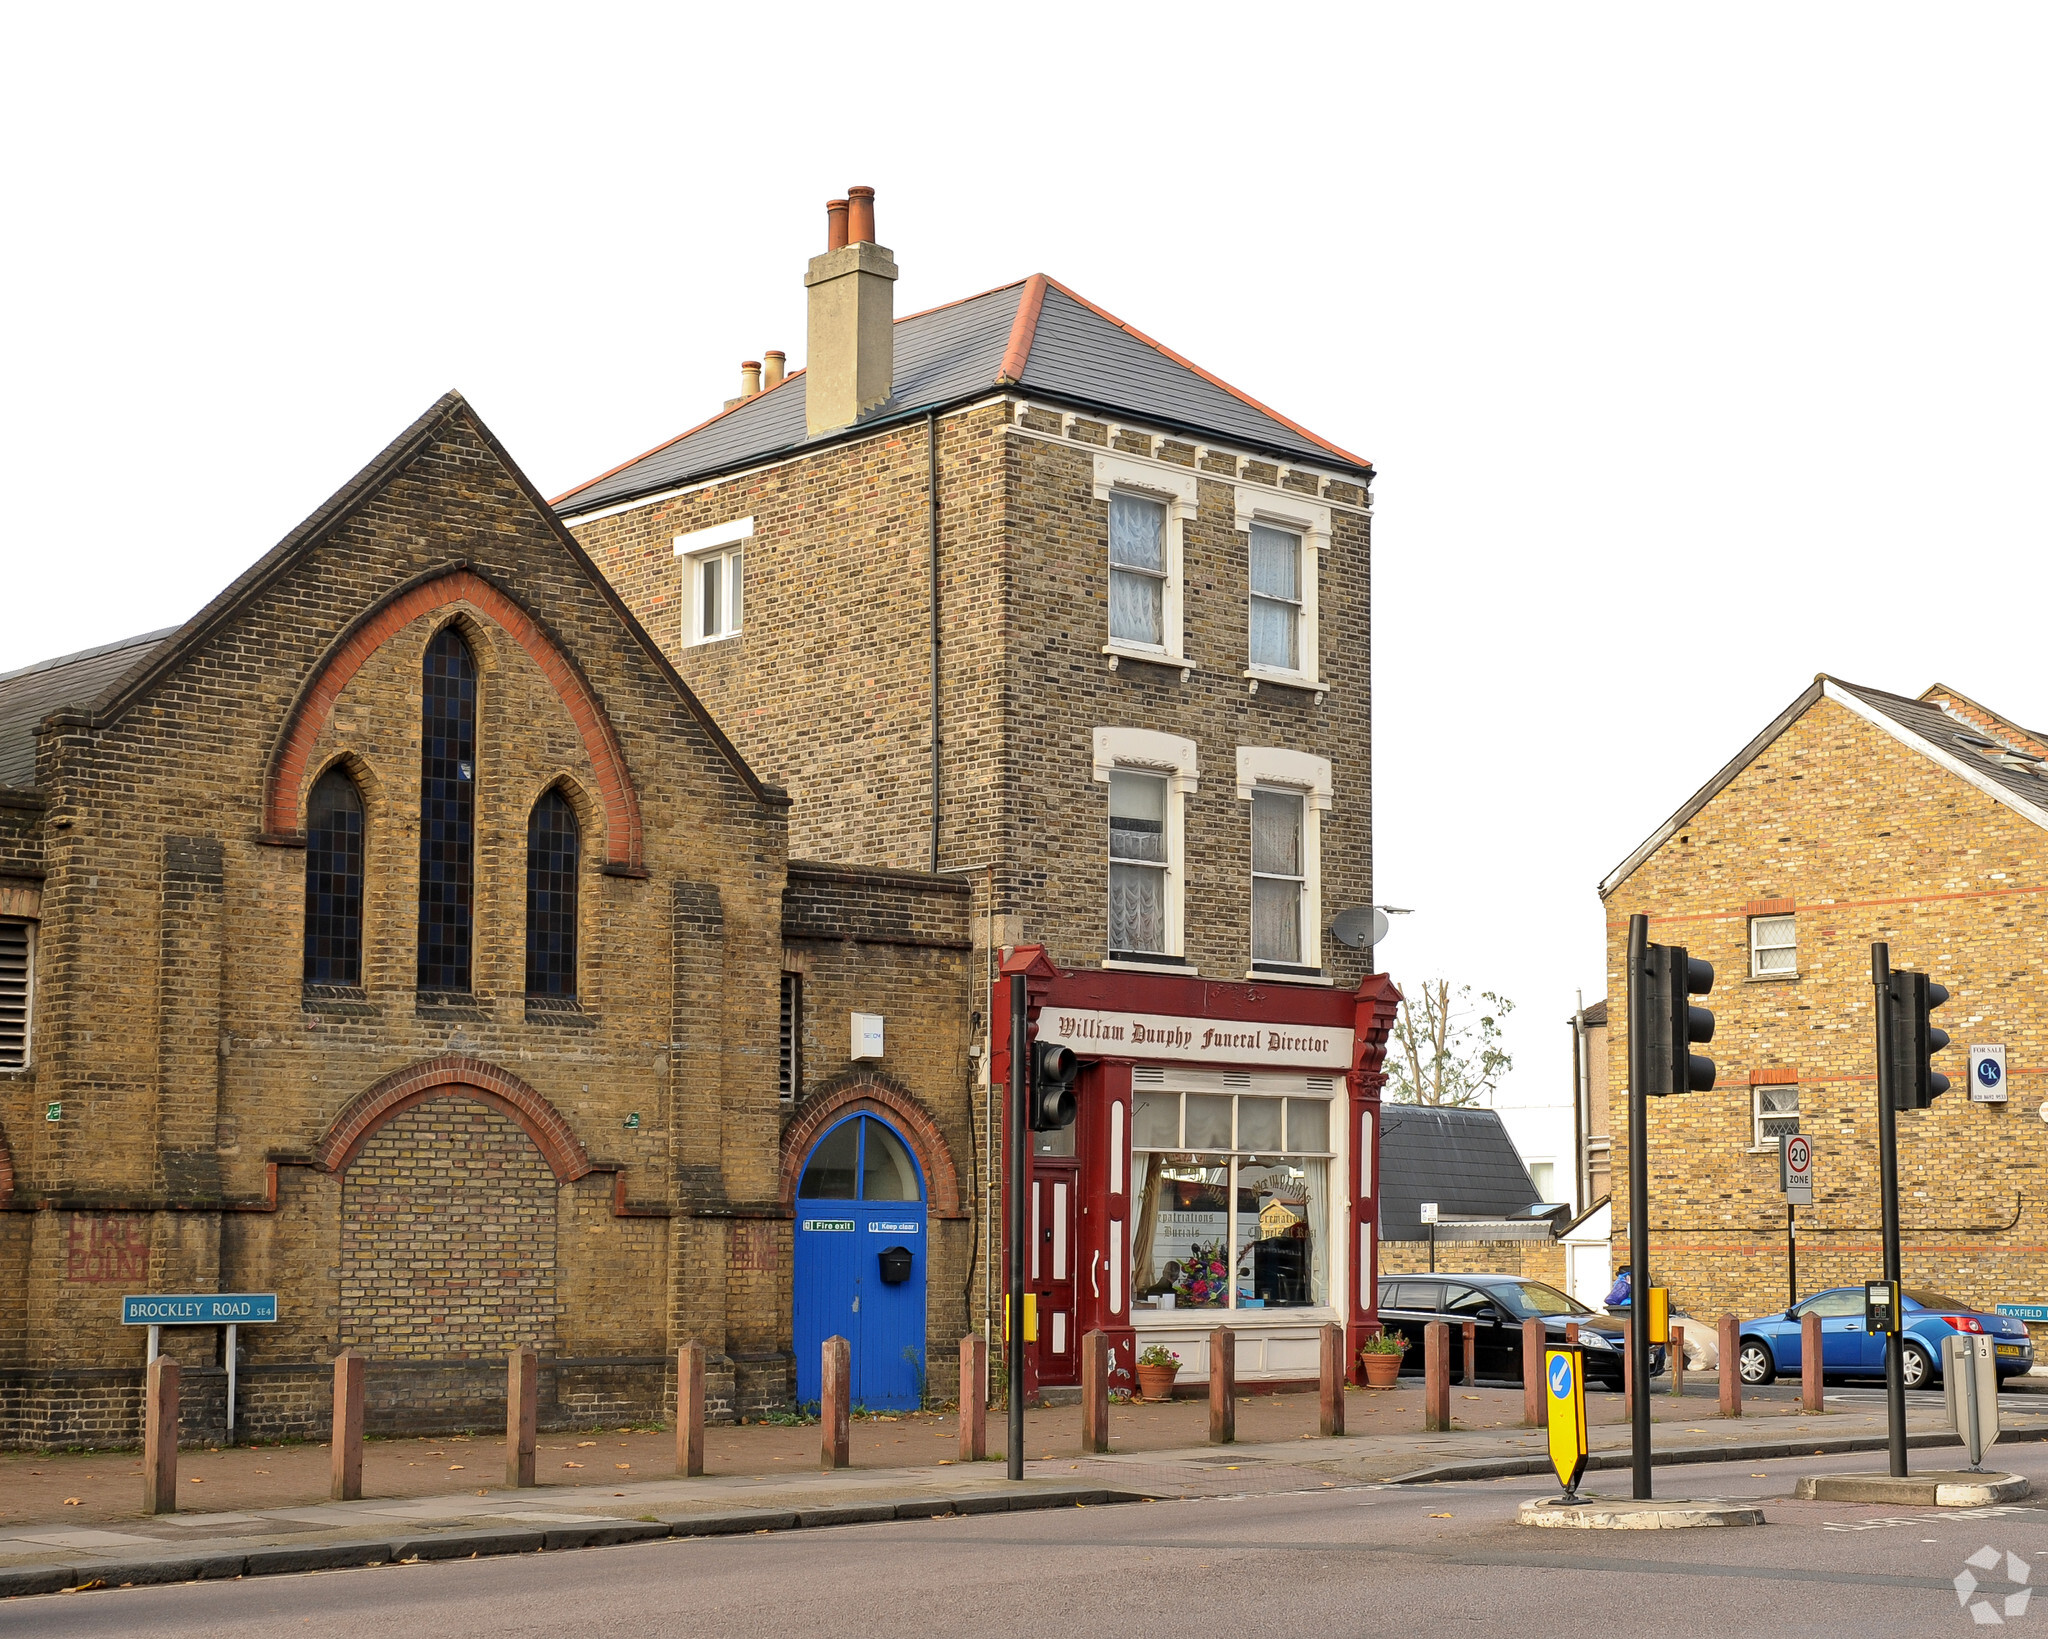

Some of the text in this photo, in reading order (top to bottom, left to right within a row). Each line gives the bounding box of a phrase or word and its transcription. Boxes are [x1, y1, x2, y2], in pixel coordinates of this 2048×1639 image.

[1059, 1016, 1329, 1053] William Dunphy Funeral Director
[1980, 1063, 1998, 1079] CK
[1791, 1148, 1807, 1162] 20
[1789, 1175, 1809, 1184] ZONE
[1158, 1212, 1214, 1223] epatriations
[816, 1220, 851, 1230] Fire exit
[881, 1223, 898, 1232] Keep
[1164, 1225, 1200, 1239] Burials
[130, 1302, 271, 1317] BROCKLEY ROAD SE4
[1997, 1308, 2042, 1317] BRAXFIELD
[1980, 1349, 1987, 1357] 3
